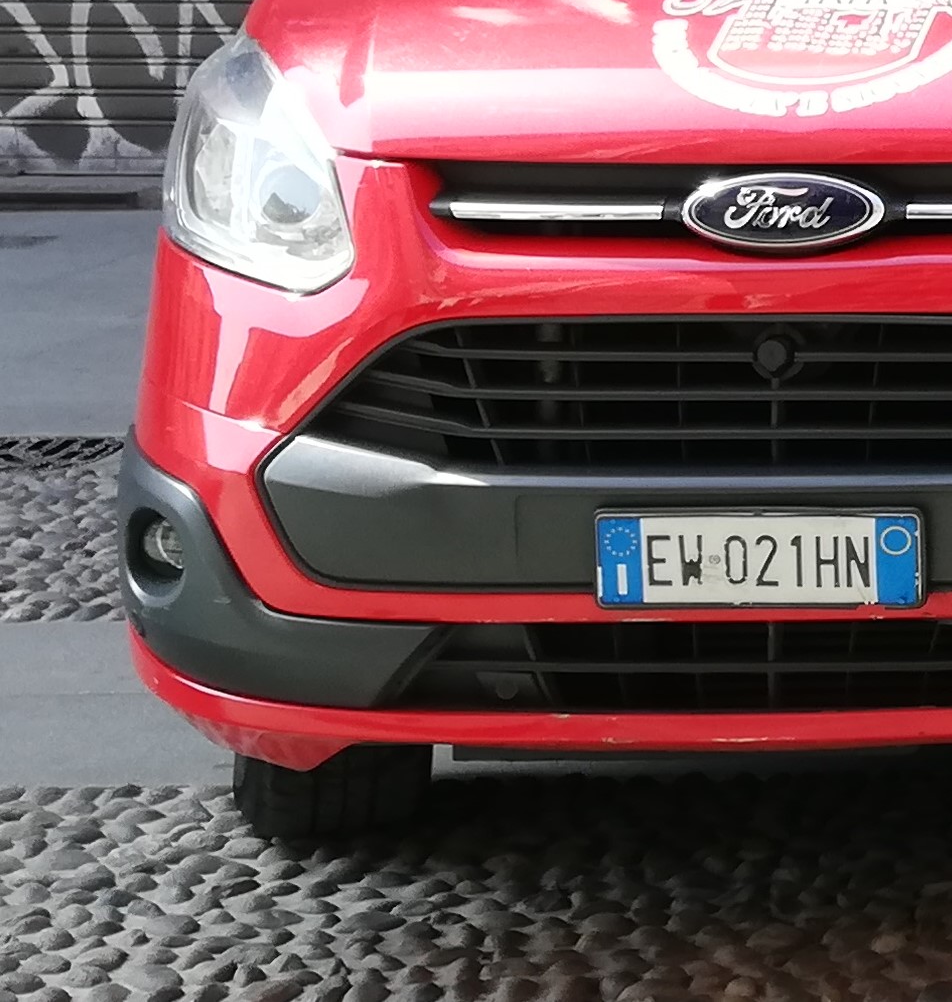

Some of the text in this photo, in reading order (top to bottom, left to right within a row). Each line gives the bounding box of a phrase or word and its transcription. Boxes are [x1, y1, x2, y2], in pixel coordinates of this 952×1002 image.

[724, 185, 834, 229] Ford
[646, 534, 703, 587] EW
[724, 534, 871, 588] 021HN
